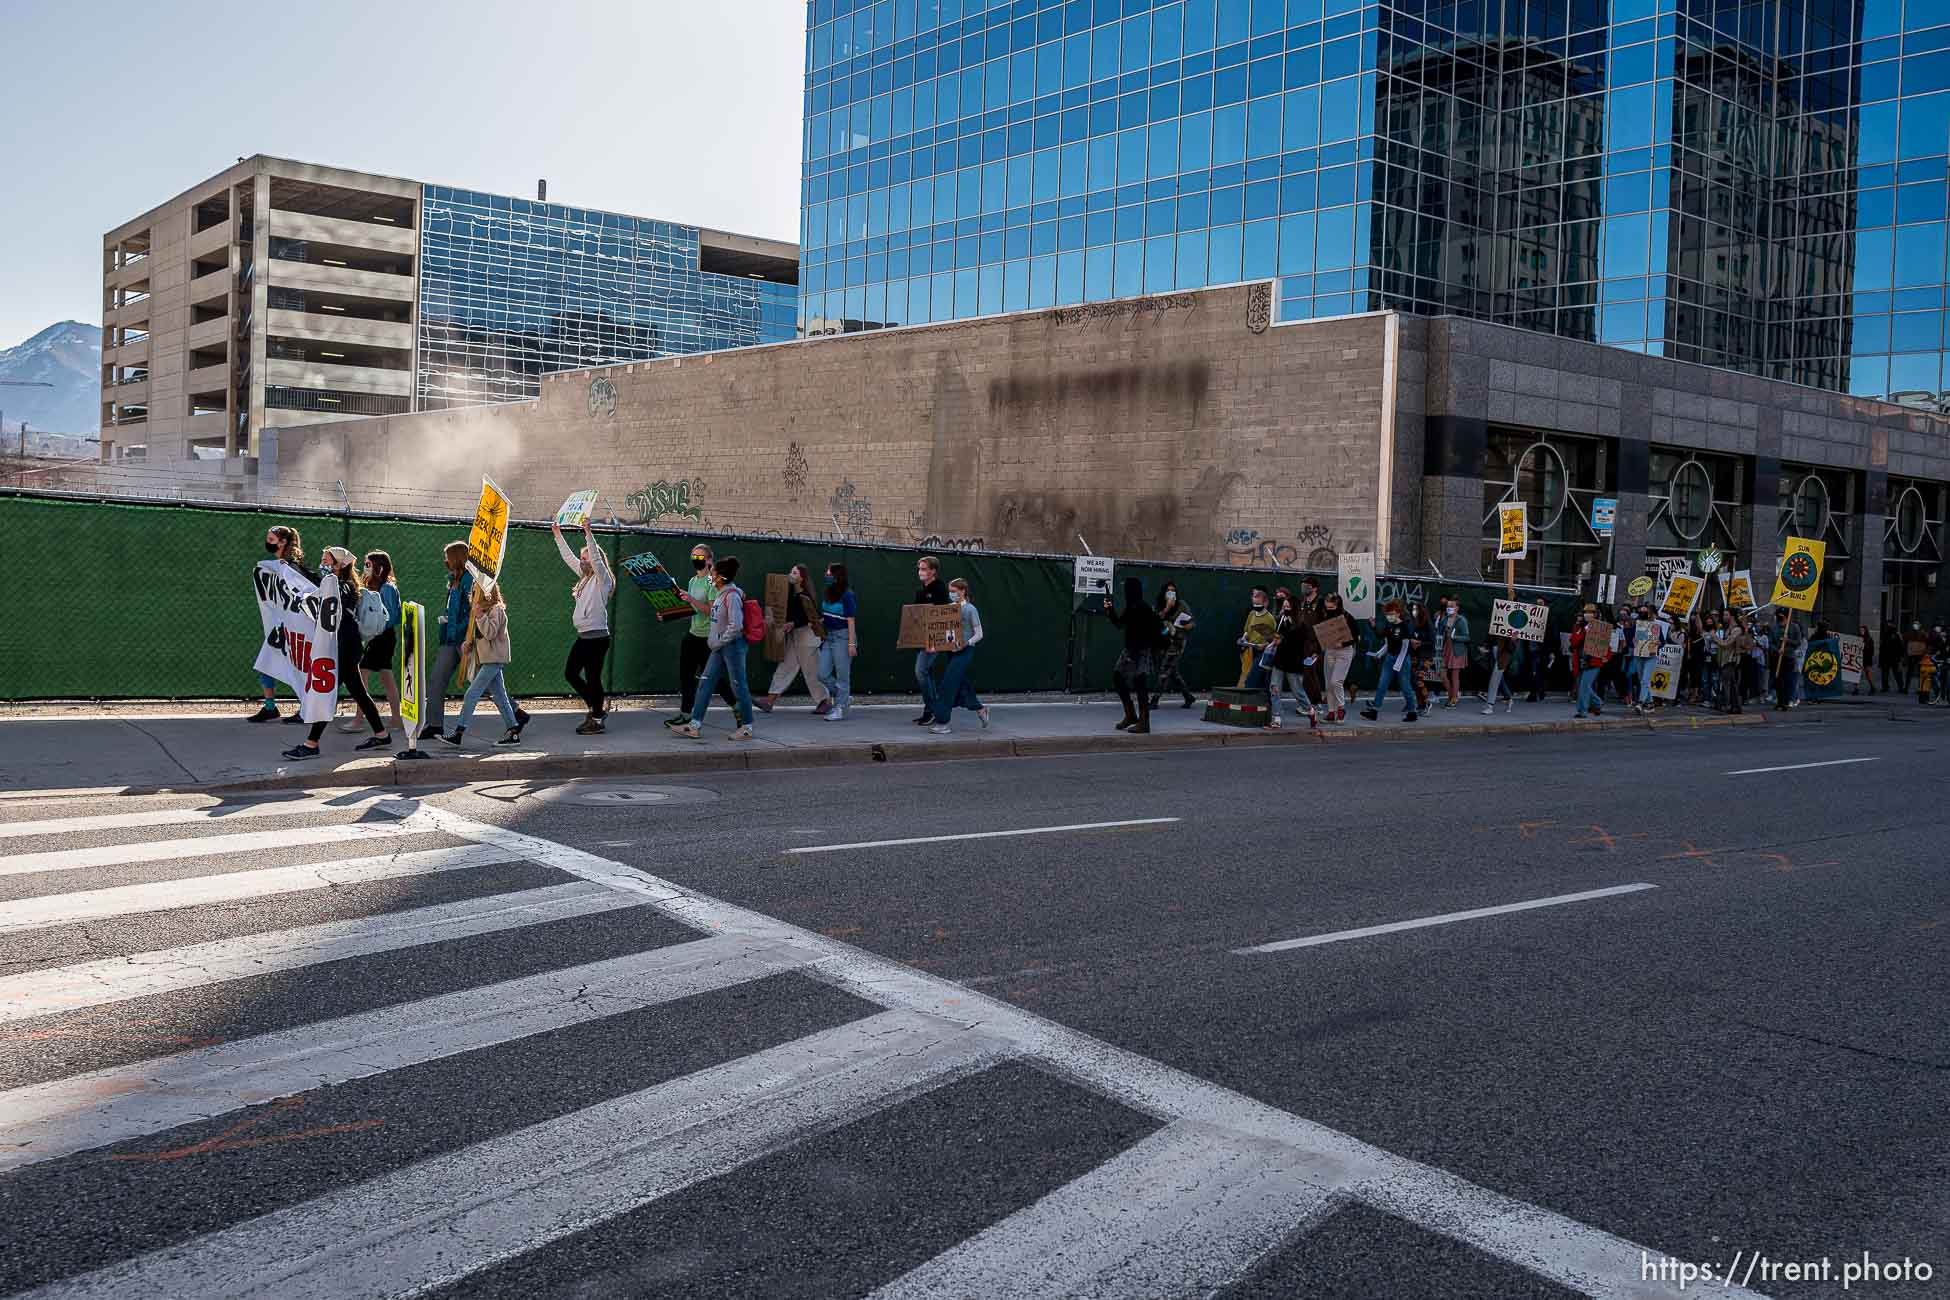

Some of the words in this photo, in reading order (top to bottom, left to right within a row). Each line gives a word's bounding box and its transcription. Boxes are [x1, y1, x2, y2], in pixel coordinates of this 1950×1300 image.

[1797, 544, 1810, 552] SUN
[1495, 602, 1511, 611] We
[1513, 603, 1527, 611] are
[1530, 606, 1544, 618] all
[1529, 618, 1545, 630] this
